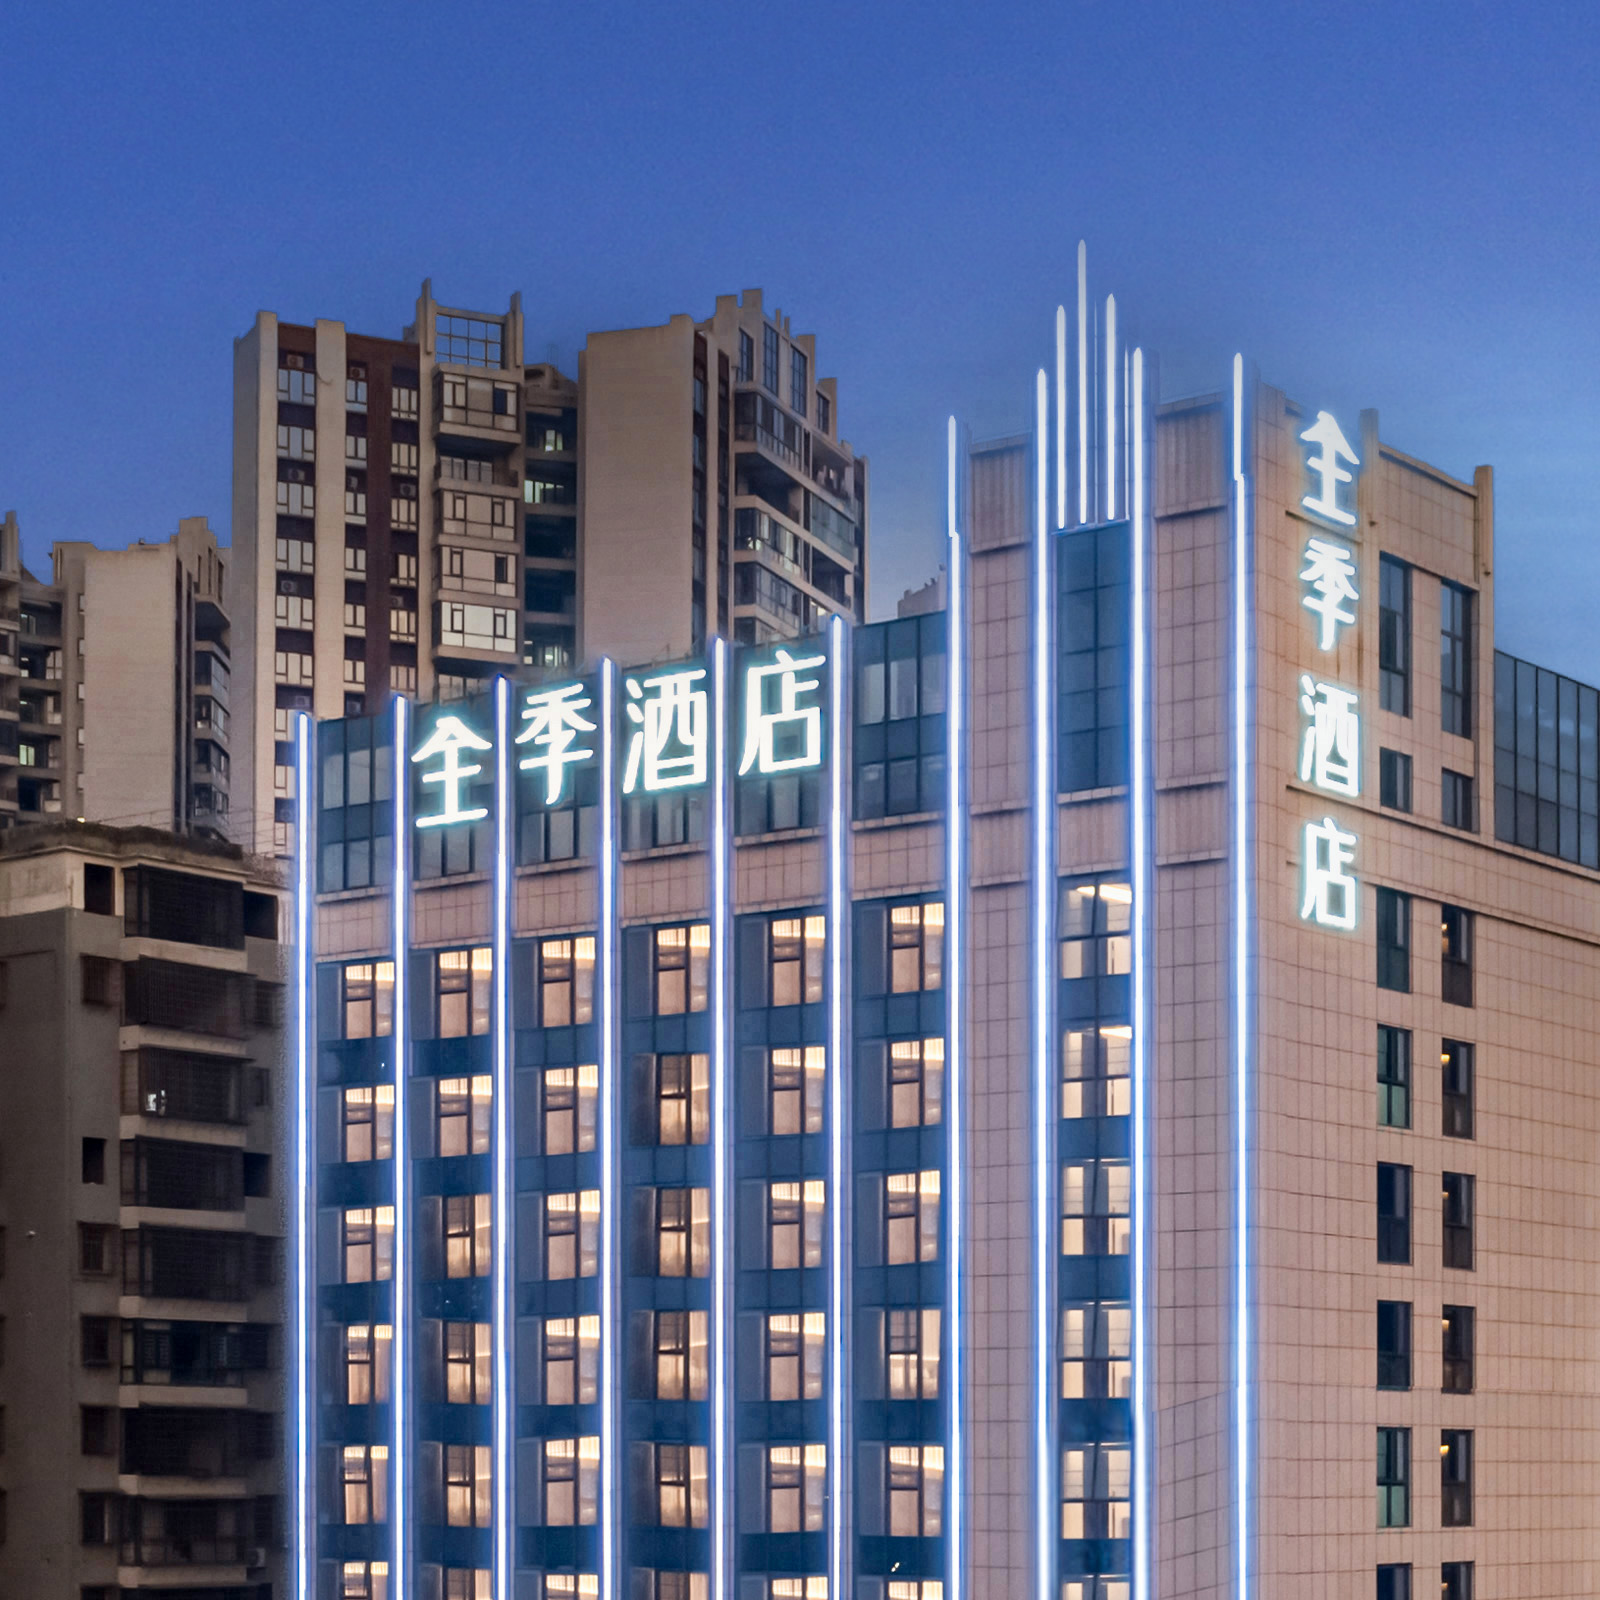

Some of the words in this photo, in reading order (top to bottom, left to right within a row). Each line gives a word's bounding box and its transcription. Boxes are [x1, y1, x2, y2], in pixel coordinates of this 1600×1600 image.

[411, 650, 826, 828] 全季酒店
[1300, 411, 1360, 931] 全季酒店
